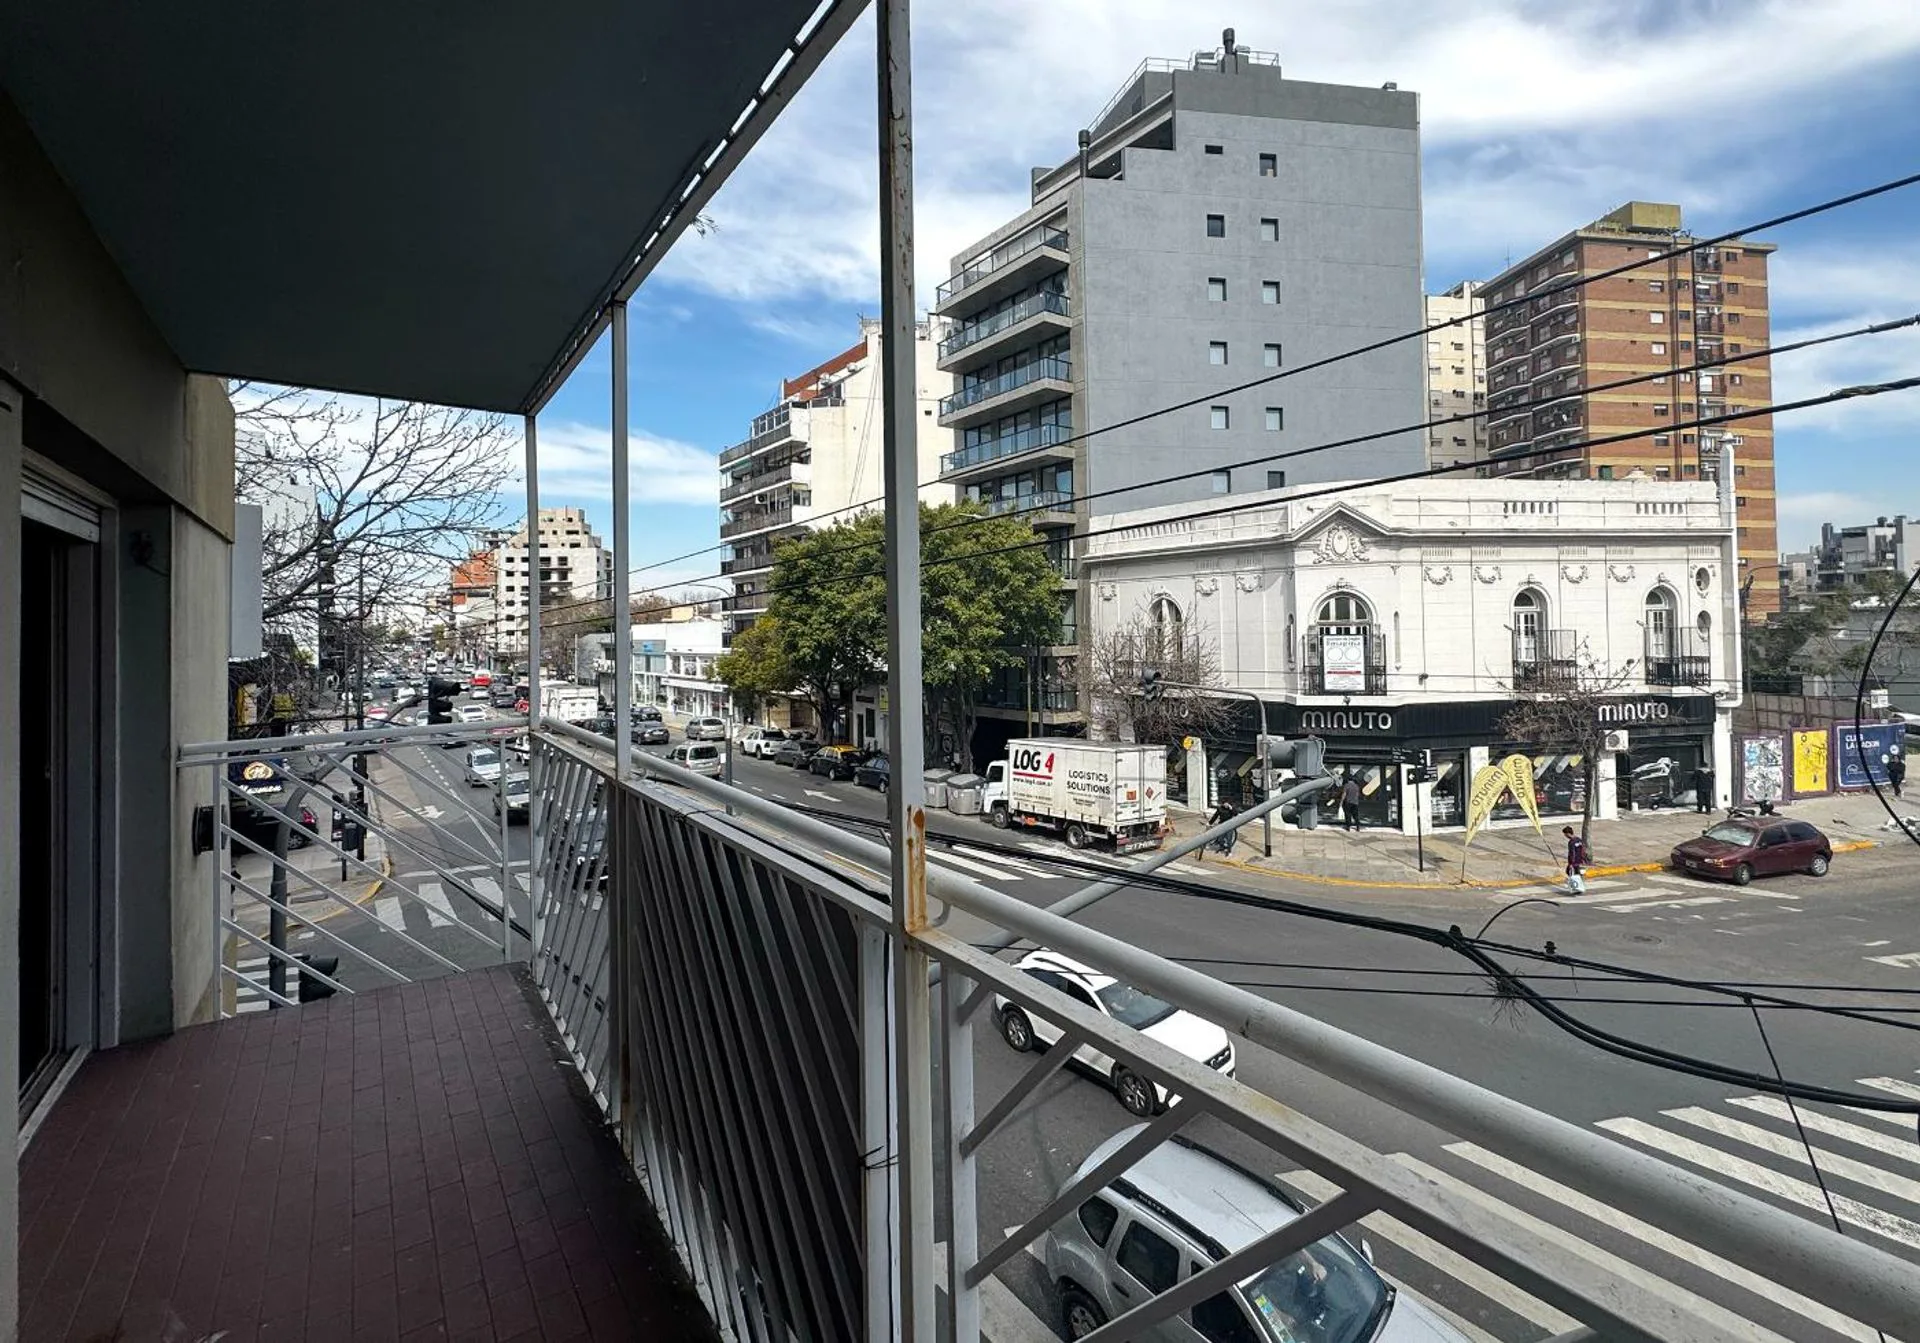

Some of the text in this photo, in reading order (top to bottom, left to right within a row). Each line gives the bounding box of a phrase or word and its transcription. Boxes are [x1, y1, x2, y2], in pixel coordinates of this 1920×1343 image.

[1302, 710, 1392, 730] MINUTO
[1598, 701, 1669, 721] MINUTO
[1013, 749, 1055, 774] LOG 4
[1068, 769, 1108, 783] LOGISTICS
[1066, 780, 1111, 795] SOLUTIONS
